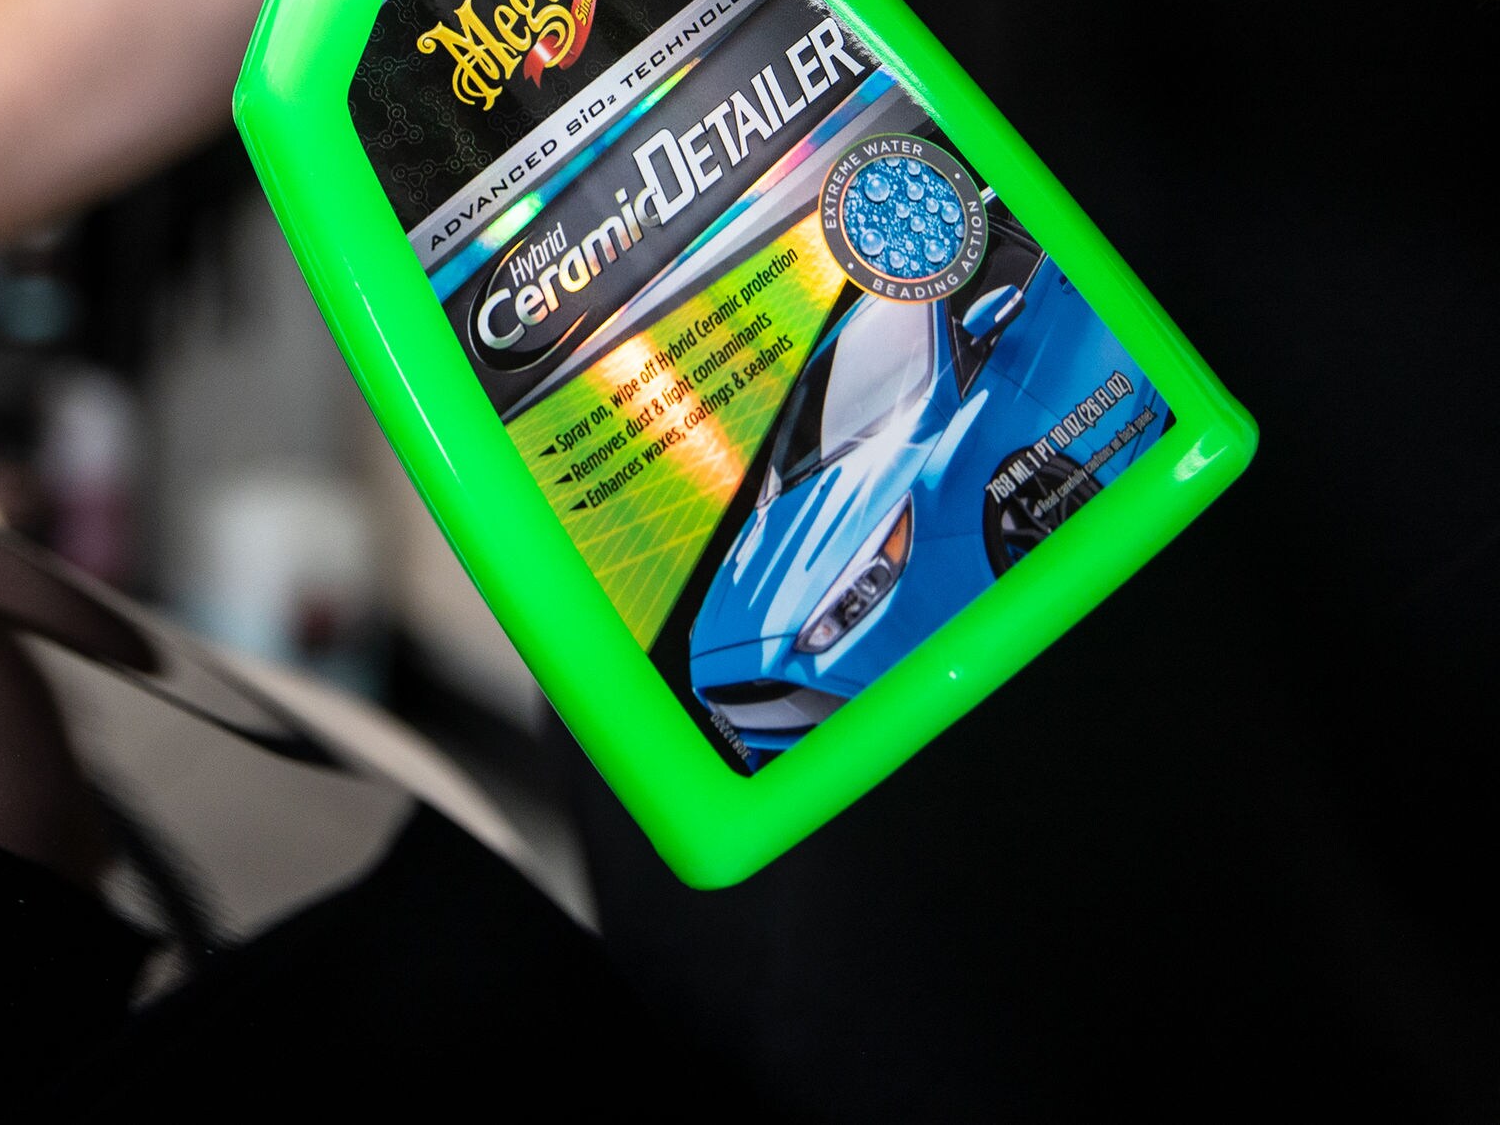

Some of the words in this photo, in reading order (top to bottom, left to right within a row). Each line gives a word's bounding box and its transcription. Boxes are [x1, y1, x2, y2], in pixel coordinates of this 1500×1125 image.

[429, 139, 558, 251] ADVANCED
[824, 153, 862, 230] EXTREME
[862, 139, 924, 158] WATER
[508, 221, 568, 289] Hybrid
[872, 274, 959, 300] BEADING
[961, 200, 983, 273] ACTION
[555, 417, 592, 453] Spray
[590, 403, 614, 424] on,
[609, 378, 641, 410] wipe
[639, 361, 660, 384] off
[655, 331, 698, 372] Hybrid
[693, 293, 743, 339] Ceramic
[740, 246, 799, 305] protection
[570, 430, 627, 483] Removes
[626, 408, 655, 439] dust
[651, 397, 665, 416] &
[661, 374, 695, 409] light
[692, 310, 773, 384] contaminants
[586, 455, 645, 509] Enhances
[642, 425, 687, 465] waxes,
[683, 380, 735, 430] coatings
[731, 370, 746, 390] &
[743, 331, 794, 383] sealants
[985, 473, 1017, 505] 768
[1007, 459, 1036, 486] ML
[1026, 451, 1042, 469] 1
[1034, 436, 1056, 463] PT
[1049, 425, 1072, 449] 10
[1062, 412, 1086, 439] OZ
[1076, 396, 1104, 427] (26
[1094, 387, 1114, 410] FL
[1105, 370, 1134, 401] OZ)
